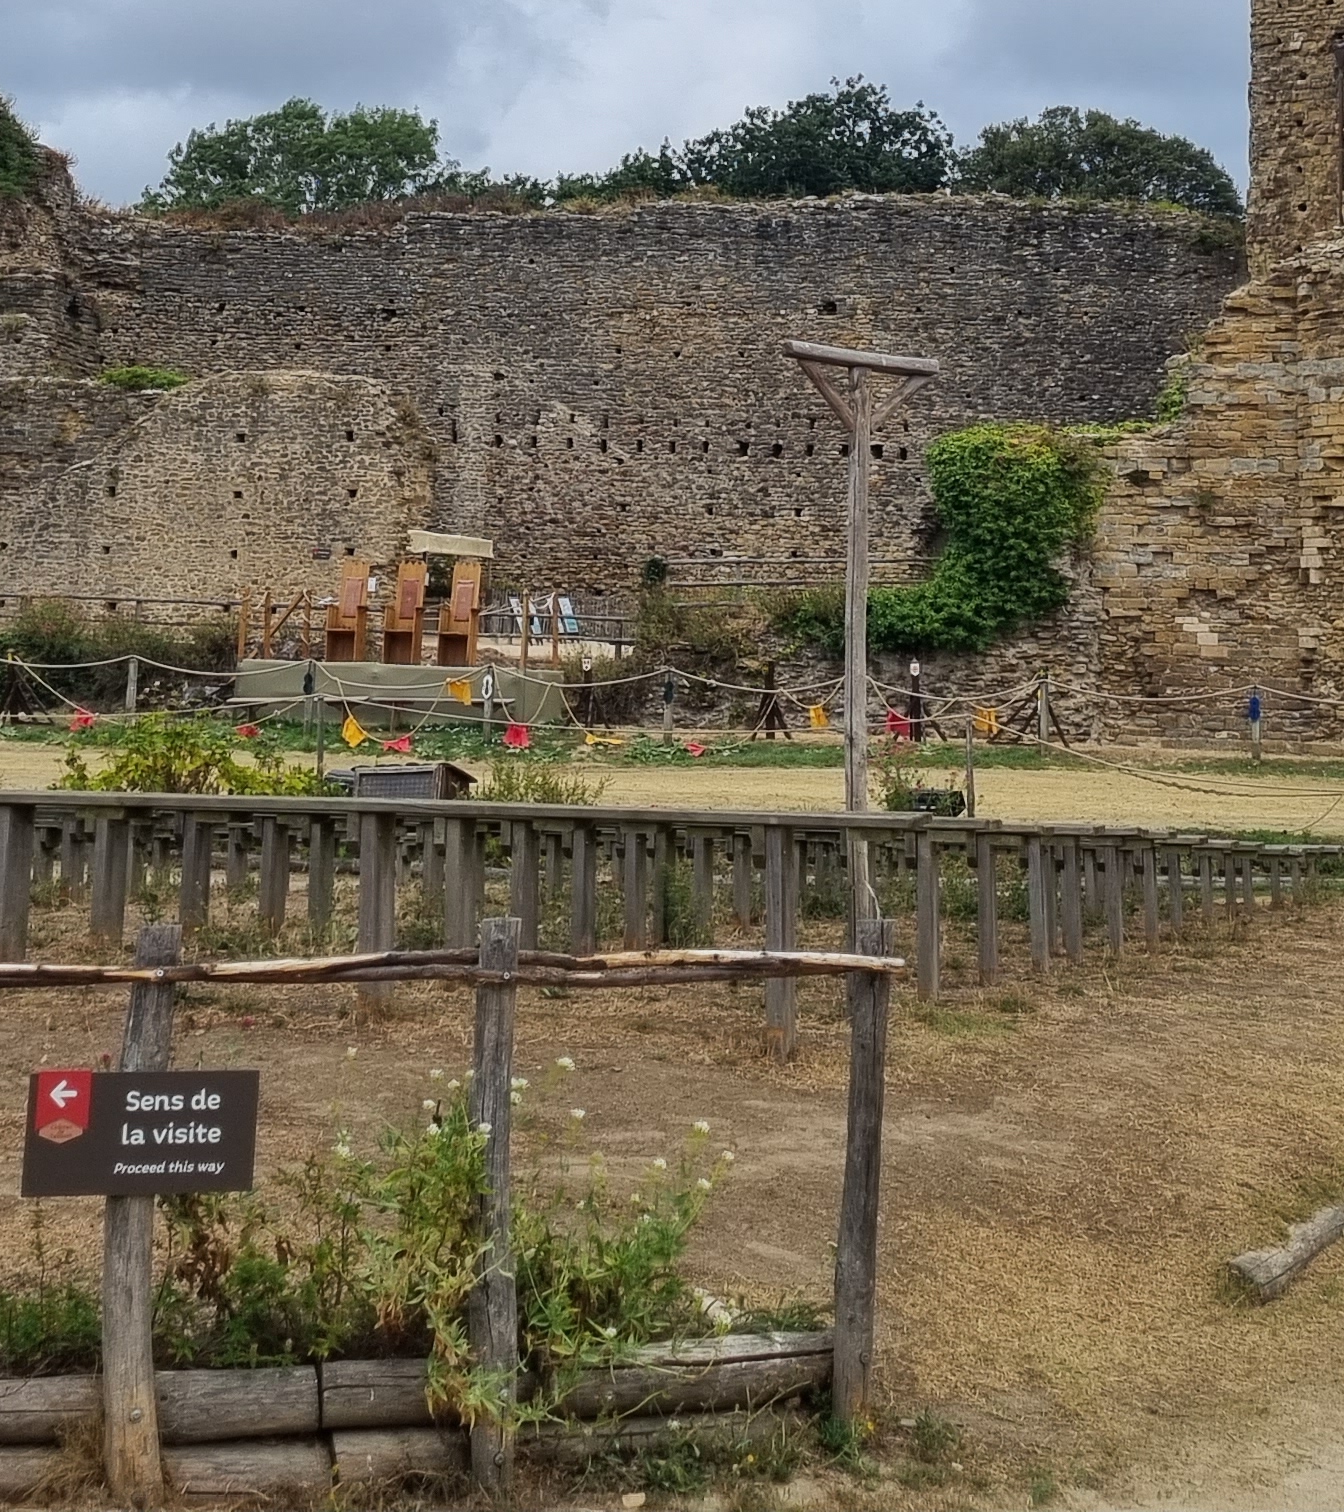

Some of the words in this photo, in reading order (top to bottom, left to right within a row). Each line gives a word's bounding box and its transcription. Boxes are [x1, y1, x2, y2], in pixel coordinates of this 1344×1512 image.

[125, 1090, 184, 1112] Sens
[190, 1087, 221, 1110] de
[121, 1122, 146, 1146] la
[152, 1120, 222, 1145] visite
[113, 1160, 166, 1175] Proceed
[168, 1160, 195, 1173] this
[197, 1162, 226, 1175] way
